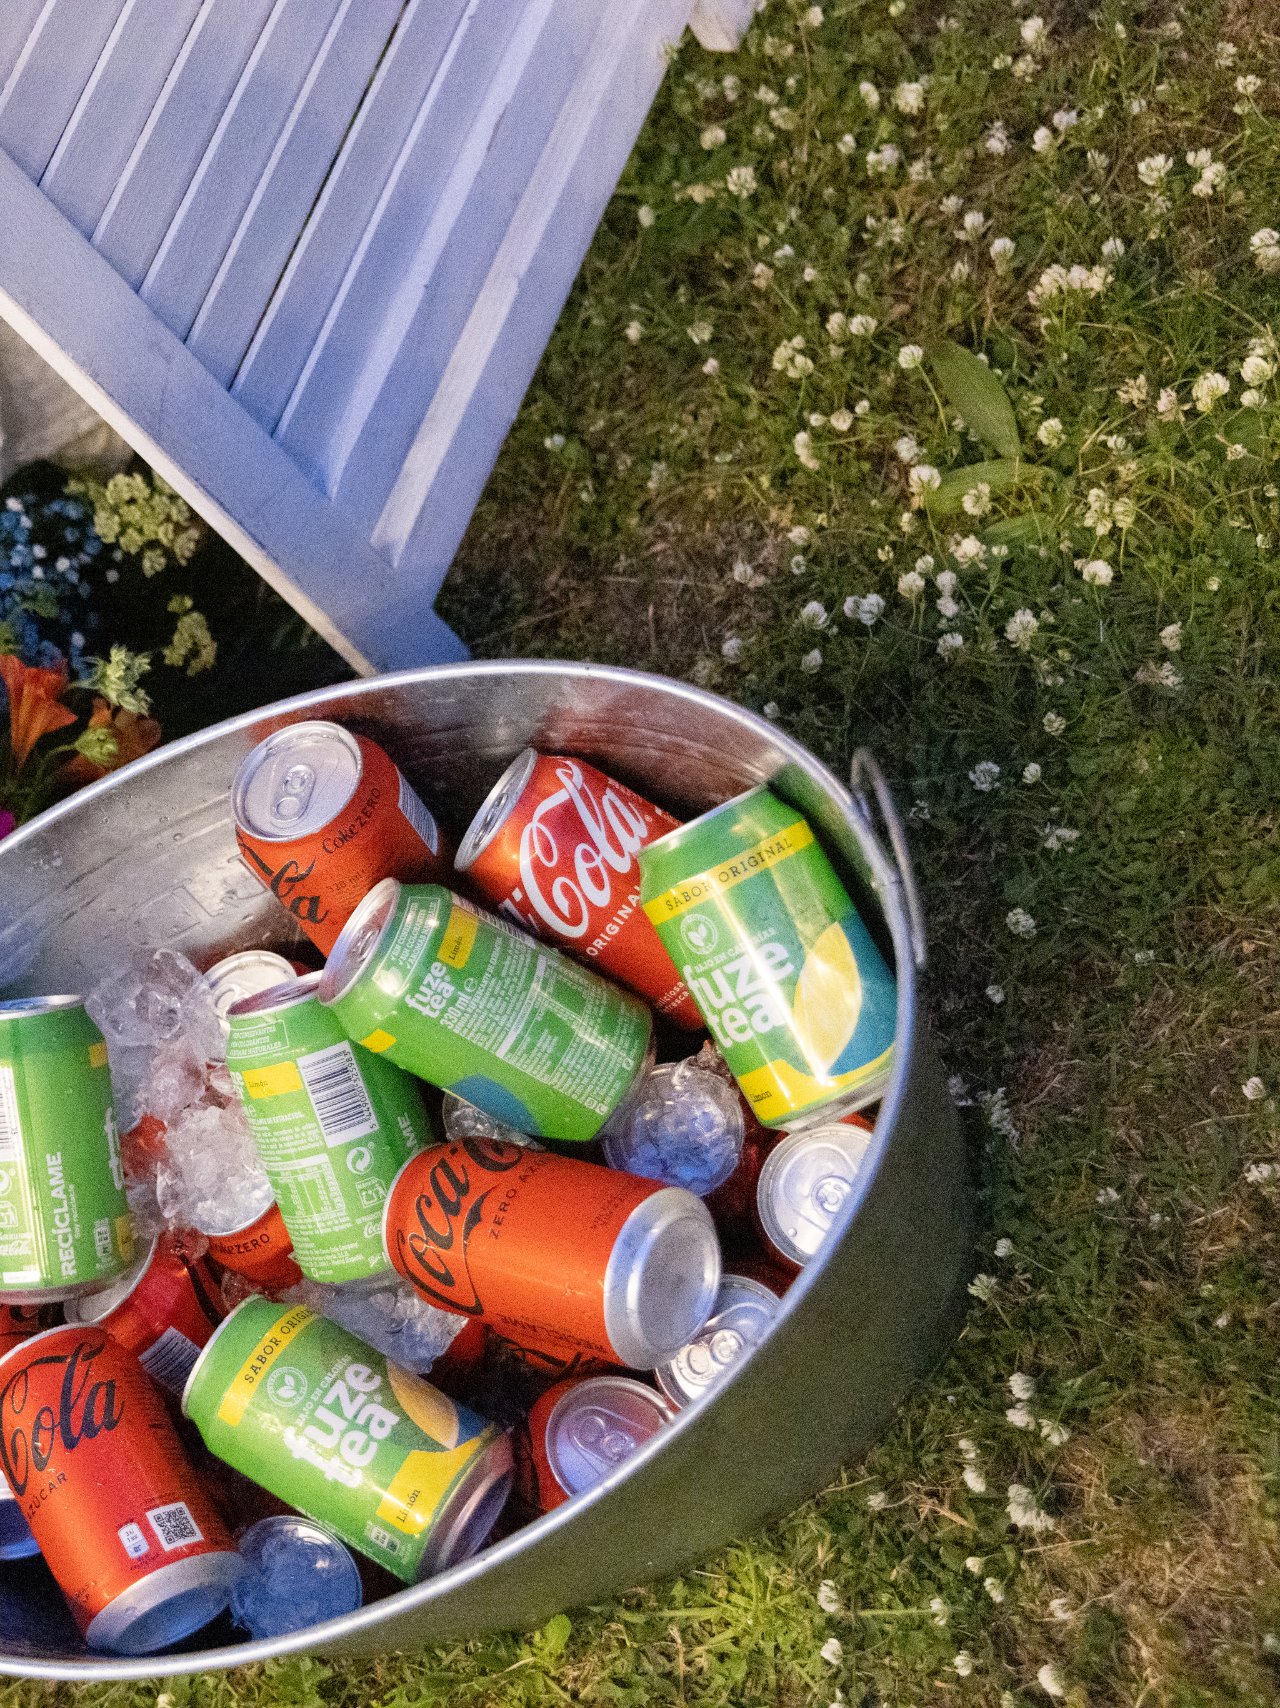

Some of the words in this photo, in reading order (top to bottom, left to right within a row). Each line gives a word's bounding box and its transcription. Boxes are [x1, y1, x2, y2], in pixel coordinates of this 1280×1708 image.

[665, 880, 712, 912] SABOR
[718, 838, 793, 884] ORIGINAL
[585, 885, 640, 957] ORIGINA
[405, 962, 447, 1010] fuze
[422, 981, 455, 1018] tea
[683, 941, 795, 1010] fuze
[440, 1007, 462, 1029] 330
[455, 991, 472, 1010] ml
[707, 990, 788, 1048] tea
[45, 1151, 77, 1279] RECÍCLAME
[489, 1188, 518, 1240] ZERO
[235, 1233, 271, 1256] ZERO
[244, 1337, 282, 1384] SABOR
[283, 1363, 381, 1462] fuze
[323, 1397, 400, 1488] tea
